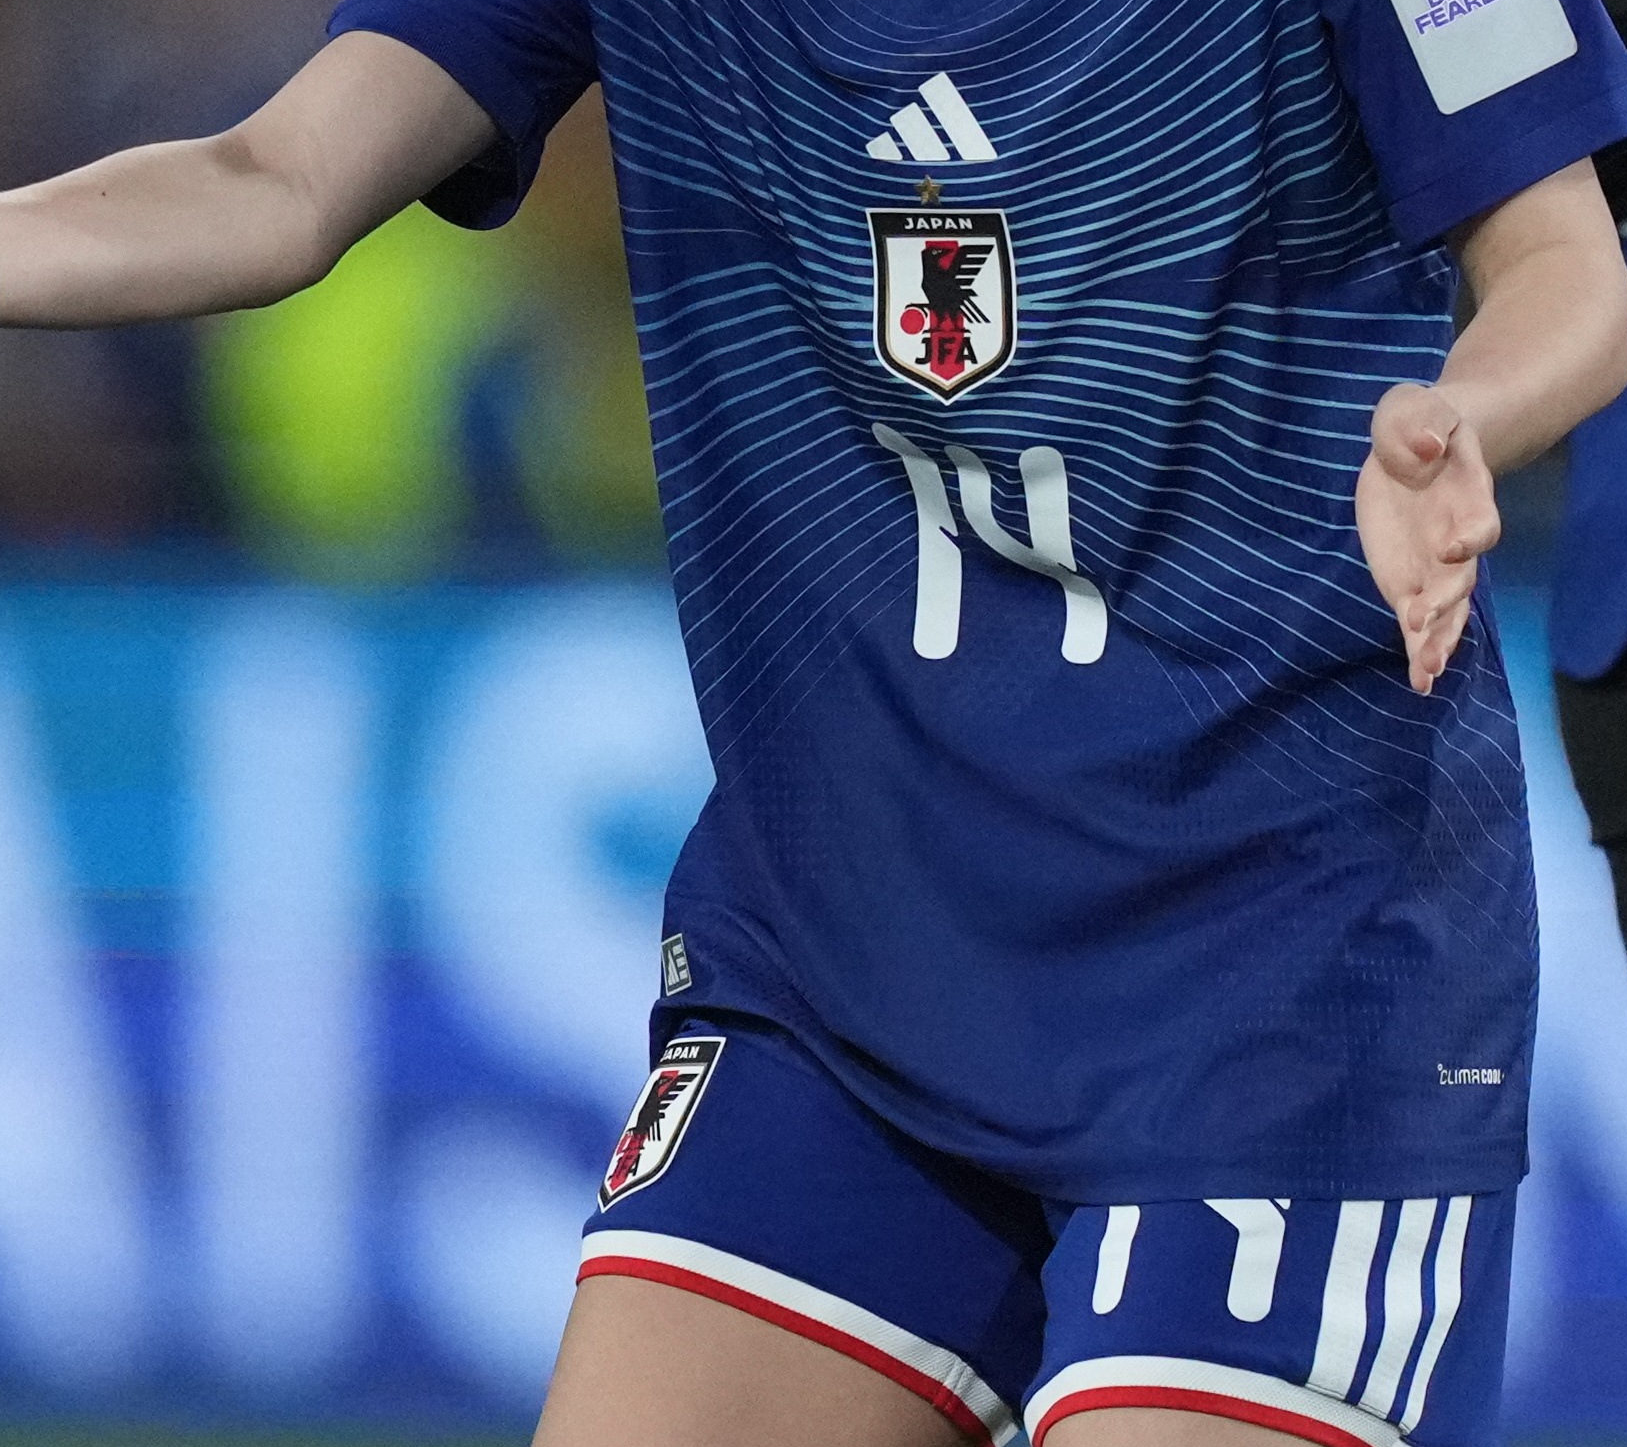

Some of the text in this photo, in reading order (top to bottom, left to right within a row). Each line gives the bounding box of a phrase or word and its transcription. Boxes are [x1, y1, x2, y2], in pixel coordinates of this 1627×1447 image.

[904, 217, 973, 230] JAPAN
[915, 337, 978, 365] JFA
[871, 422, 1108, 665] 14
